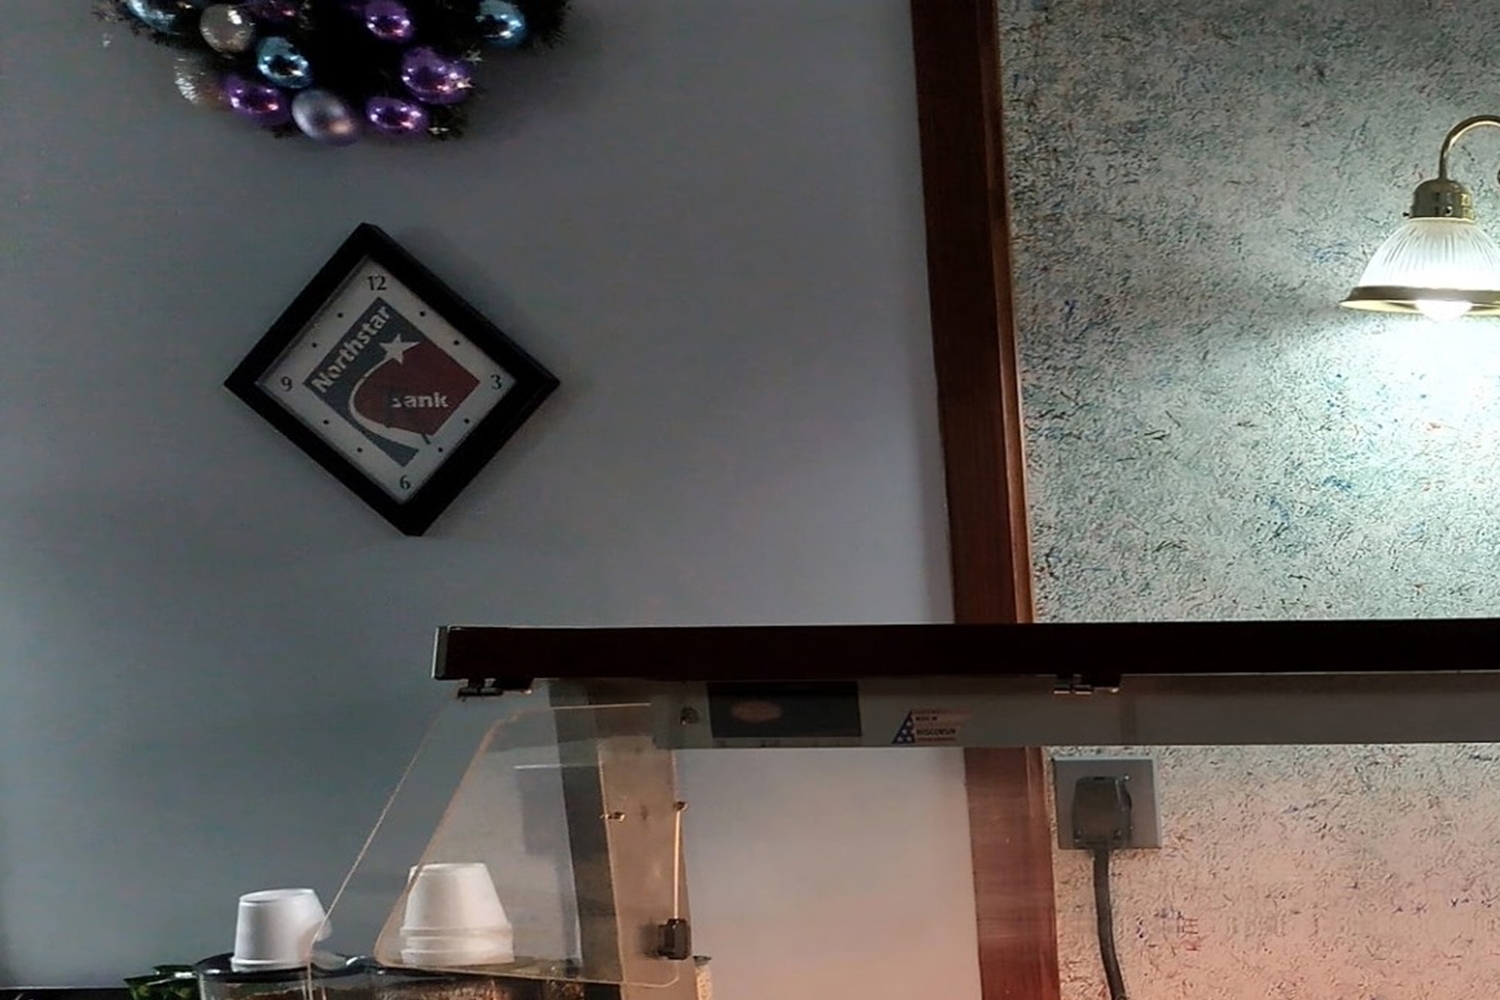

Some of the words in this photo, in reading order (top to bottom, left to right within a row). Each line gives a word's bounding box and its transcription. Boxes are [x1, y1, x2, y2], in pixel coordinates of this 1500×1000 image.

[368, 275, 387, 291] 12
[310, 305, 390, 393] Northstar
[281, 376, 293, 391] 9
[491, 373, 503, 389] 3
[400, 474, 411, 490] 6
